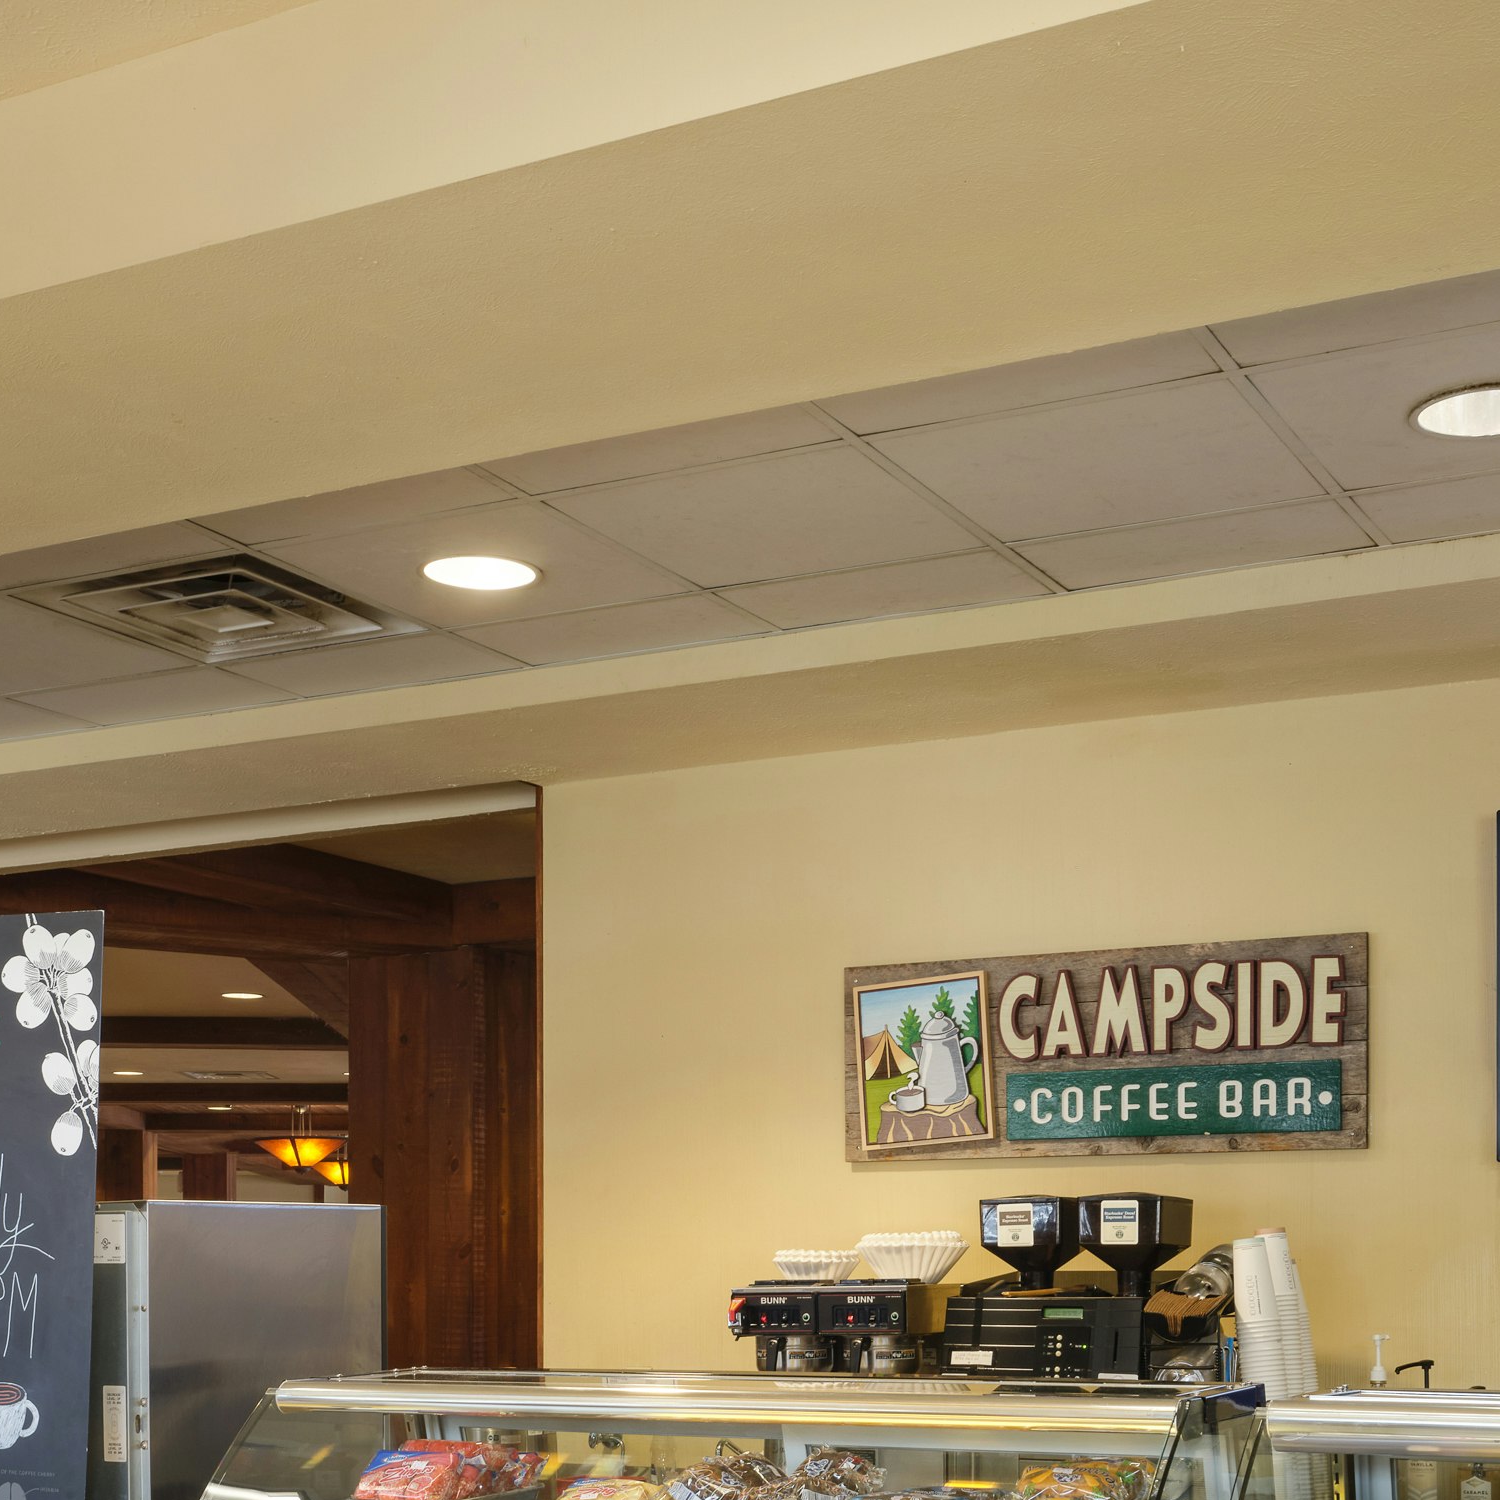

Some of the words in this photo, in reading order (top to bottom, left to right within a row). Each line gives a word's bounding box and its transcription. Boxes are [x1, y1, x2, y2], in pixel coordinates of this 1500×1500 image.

[999, 956, 1342, 1060] CAMPSIDE
[1030, 1081, 1198, 1124] COFFEE
[1219, 1077, 1312, 1118] BAR
[761, 1297, 787, 1305] BUNN
[847, 1296, 875, 1304] BUNN
